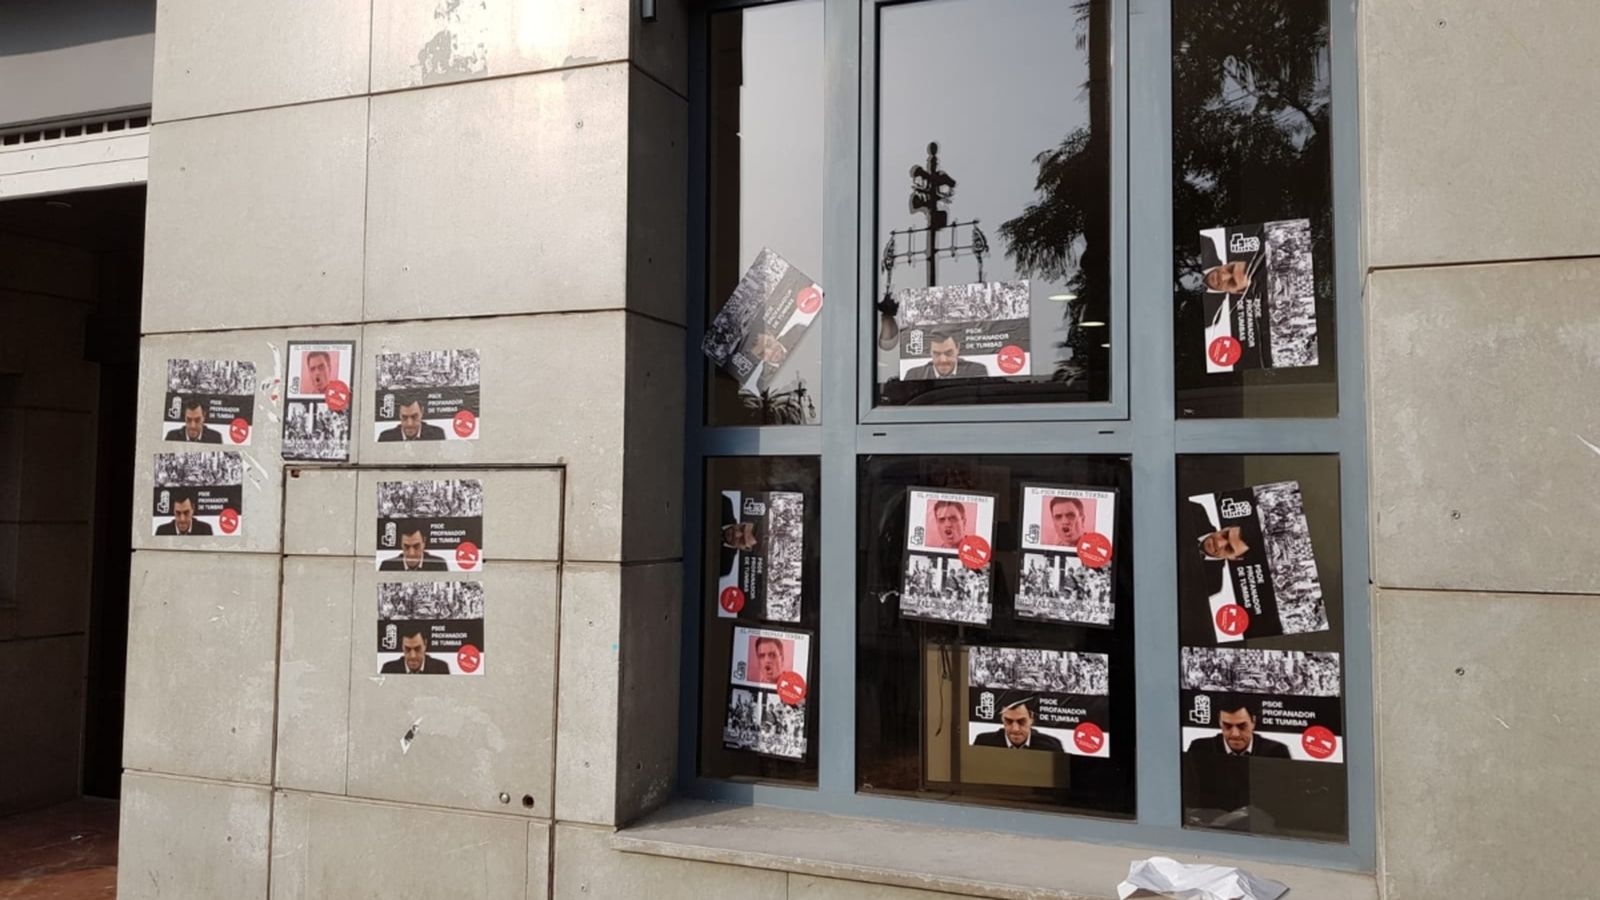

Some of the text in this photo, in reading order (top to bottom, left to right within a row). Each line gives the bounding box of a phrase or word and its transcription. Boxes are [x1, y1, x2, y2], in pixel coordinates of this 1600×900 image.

[1238, 312, 1246, 341] TUMBAS
[1245, 299, 1255, 347] PROFANADOR
[965, 333, 1009, 342] PROFANADOR
[1254, 564, 1265, 584] PSOE
[1236, 567, 1252, 609] DE TUMBAS
[1245, 565, 1262, 615] PROFANADOR
[1039, 706, 1087, 716] PROFANADOR
[1262, 709, 1316, 719] PROFANADOR
[1050, 715, 1080, 723] TUMBAS
[1275, 718, 1308, 727] TUMBAS
